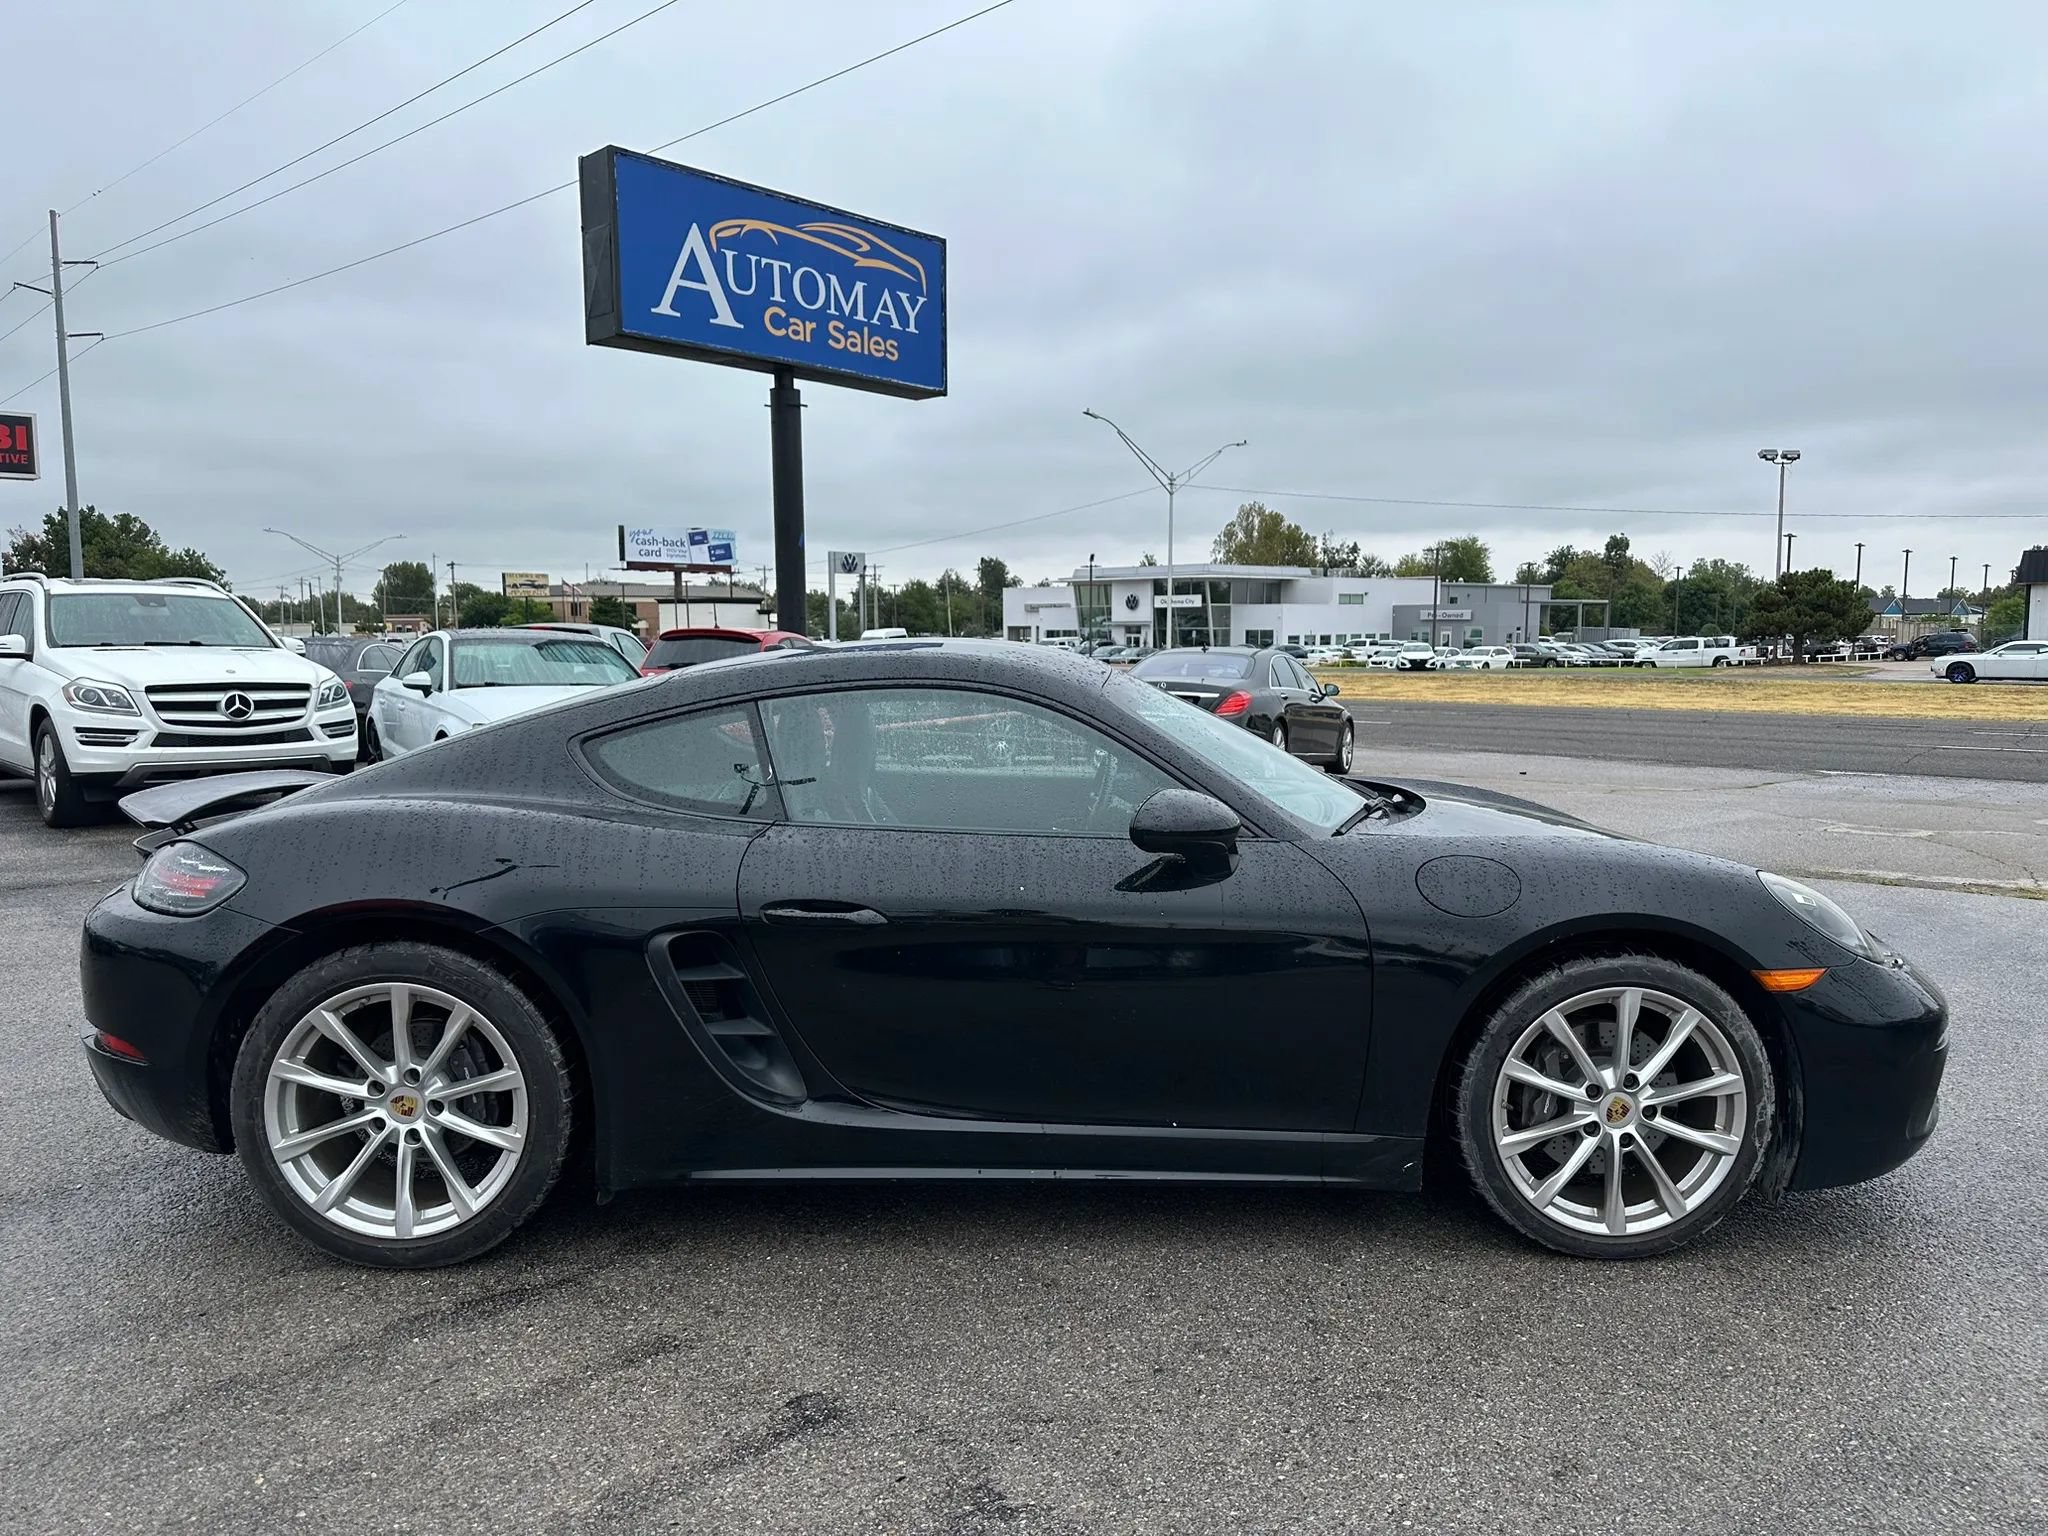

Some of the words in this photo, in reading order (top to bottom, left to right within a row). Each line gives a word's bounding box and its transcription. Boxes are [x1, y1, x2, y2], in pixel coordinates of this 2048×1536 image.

[650, 222, 927, 334] AUTOMAY
[763, 306, 816, 343] Car
[828, 320, 899, 361] Sales
[635, 536, 687, 548] cash-back
[638, 547, 662, 558] card
